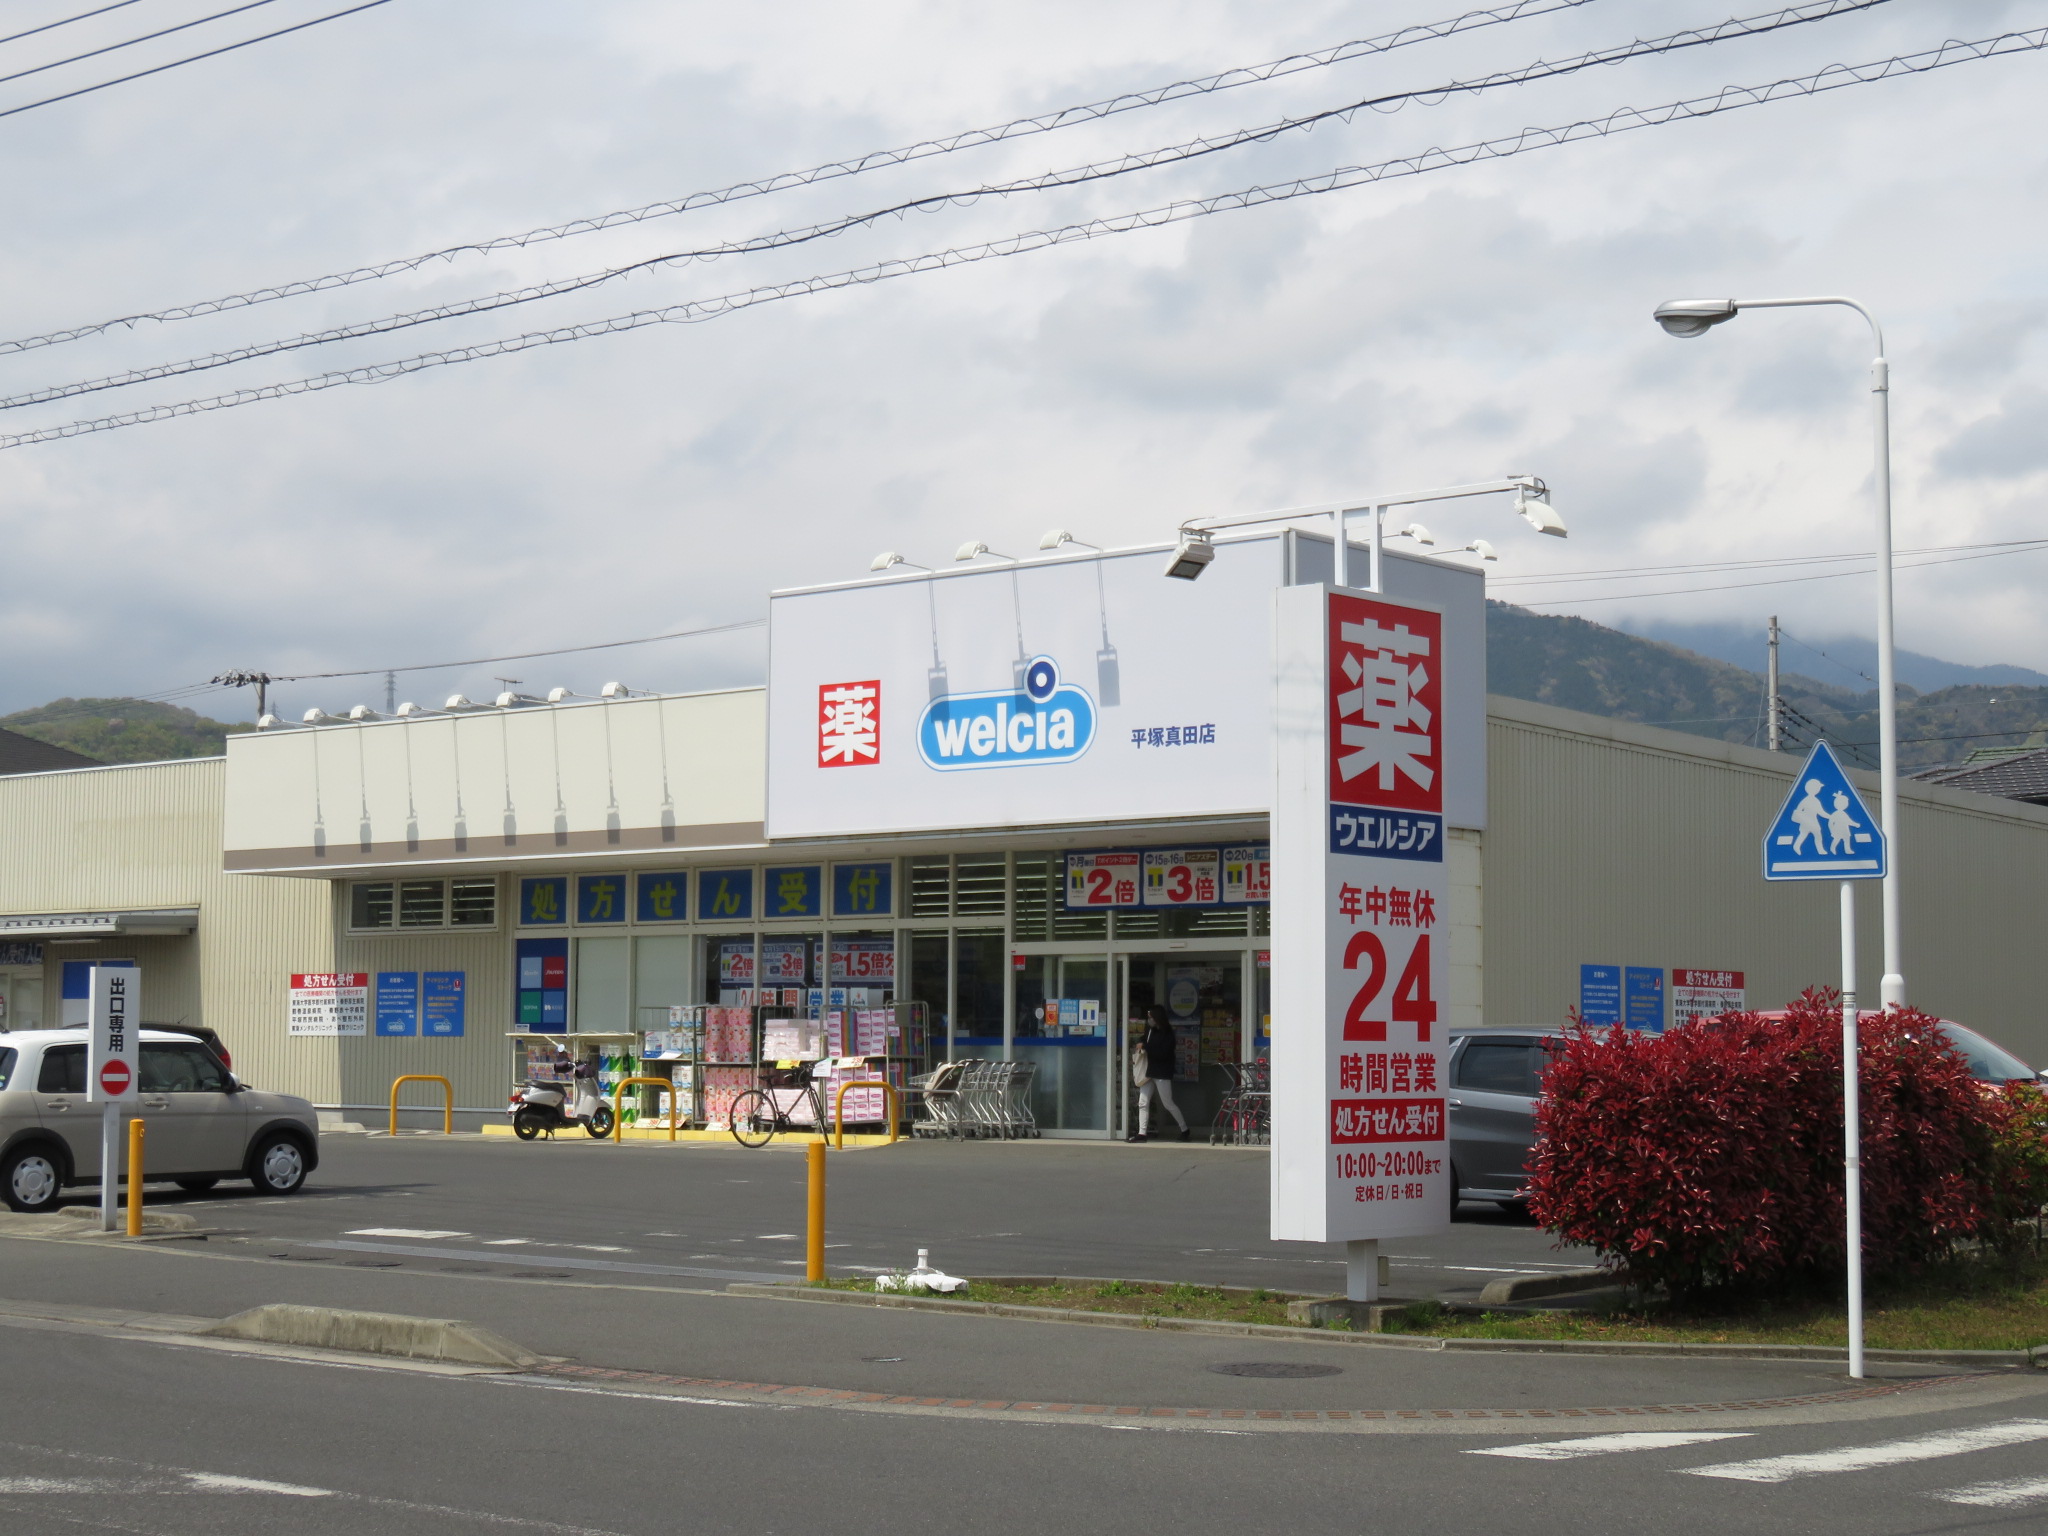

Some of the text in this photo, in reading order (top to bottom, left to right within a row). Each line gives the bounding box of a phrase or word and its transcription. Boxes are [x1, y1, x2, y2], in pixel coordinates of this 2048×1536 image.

[821, 686, 877, 763] 薬
[933, 661, 1075, 757] welcia
[1337, 617, 1434, 792] 薬
[1131, 723, 1216, 749] 平塚真田店
[1336, 813, 1435, 852] ウエルシア
[530, 869, 880, 921] 処方せん受付
[1087, 868, 1136, 904] 2倍
[1167, 865, 1215, 902] 3倍
[1339, 882, 1436, 929] 年中無休
[303, 973, 355, 988] 処方せん受付
[782, 953, 803, 970] 3倍
[1685, 970, 1733, 988] 処方せん受付
[1343, 931, 1437, 1042] 24
[109, 977, 125, 1053] 出口専用
[1340, 1053, 1437, 1094] 時間営業
[1335, 1105, 1440, 1138] 処方せん受付
